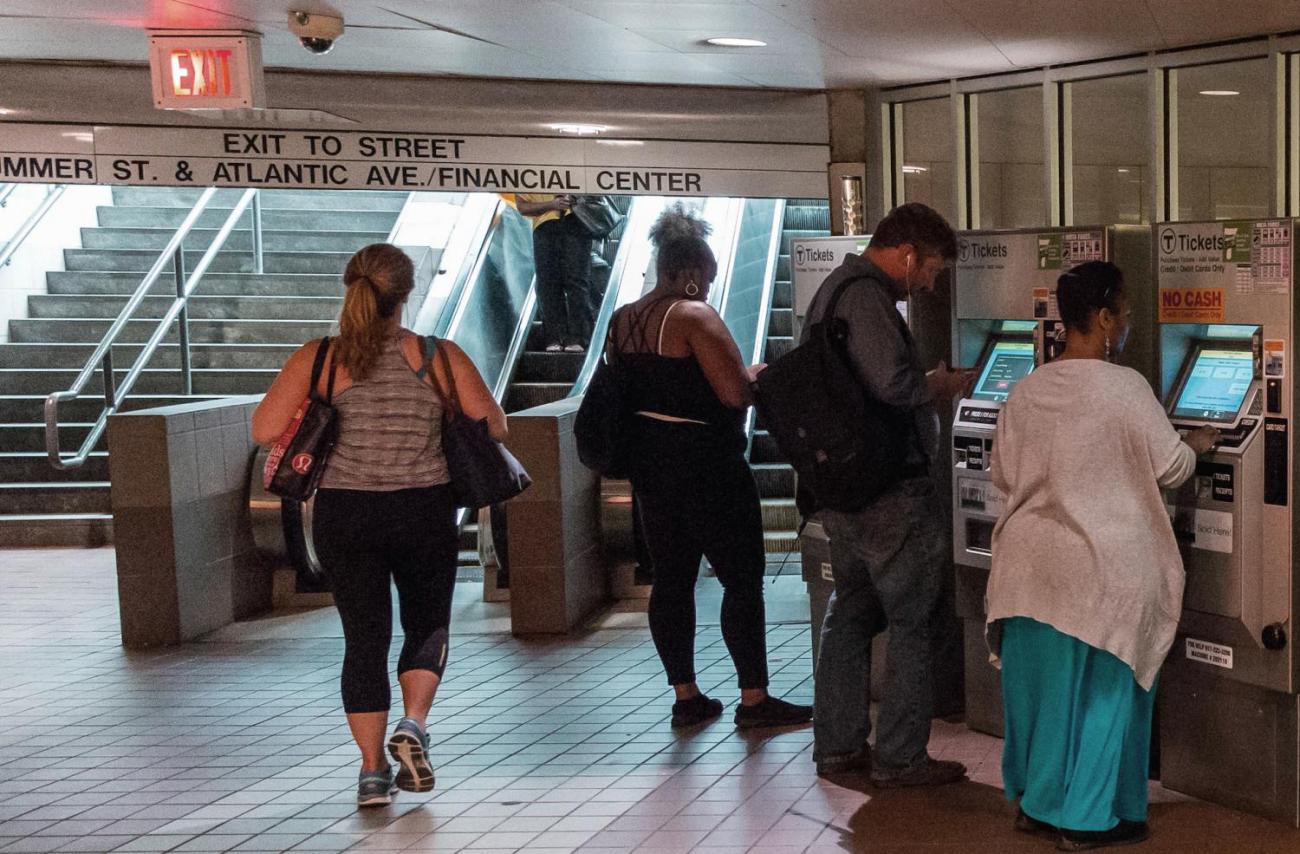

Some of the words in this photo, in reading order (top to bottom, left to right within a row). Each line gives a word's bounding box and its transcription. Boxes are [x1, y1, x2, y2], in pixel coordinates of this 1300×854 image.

[170, 50, 232, 96] EXIT
[223, 134, 285, 154] EXIT
[304, 136, 342, 156] TO
[359, 136, 465, 159] STREET
[0, 157, 93, 179] MMER
[113, 160, 157, 181] ST.
[175, 160, 193, 182] &
[213, 162, 348, 185] ATLANTIC
[366, 166, 580, 190] AVE./FINANCIAL
[596, 171, 702, 192] CENTER
[972, 243, 1007, 258] Tickets
[1179, 235, 1225, 251] Tickets
[806, 249, 834, 261] Tickets
[1163, 291, 1182, 307] NO
[1185, 291, 1222, 307] CASH
